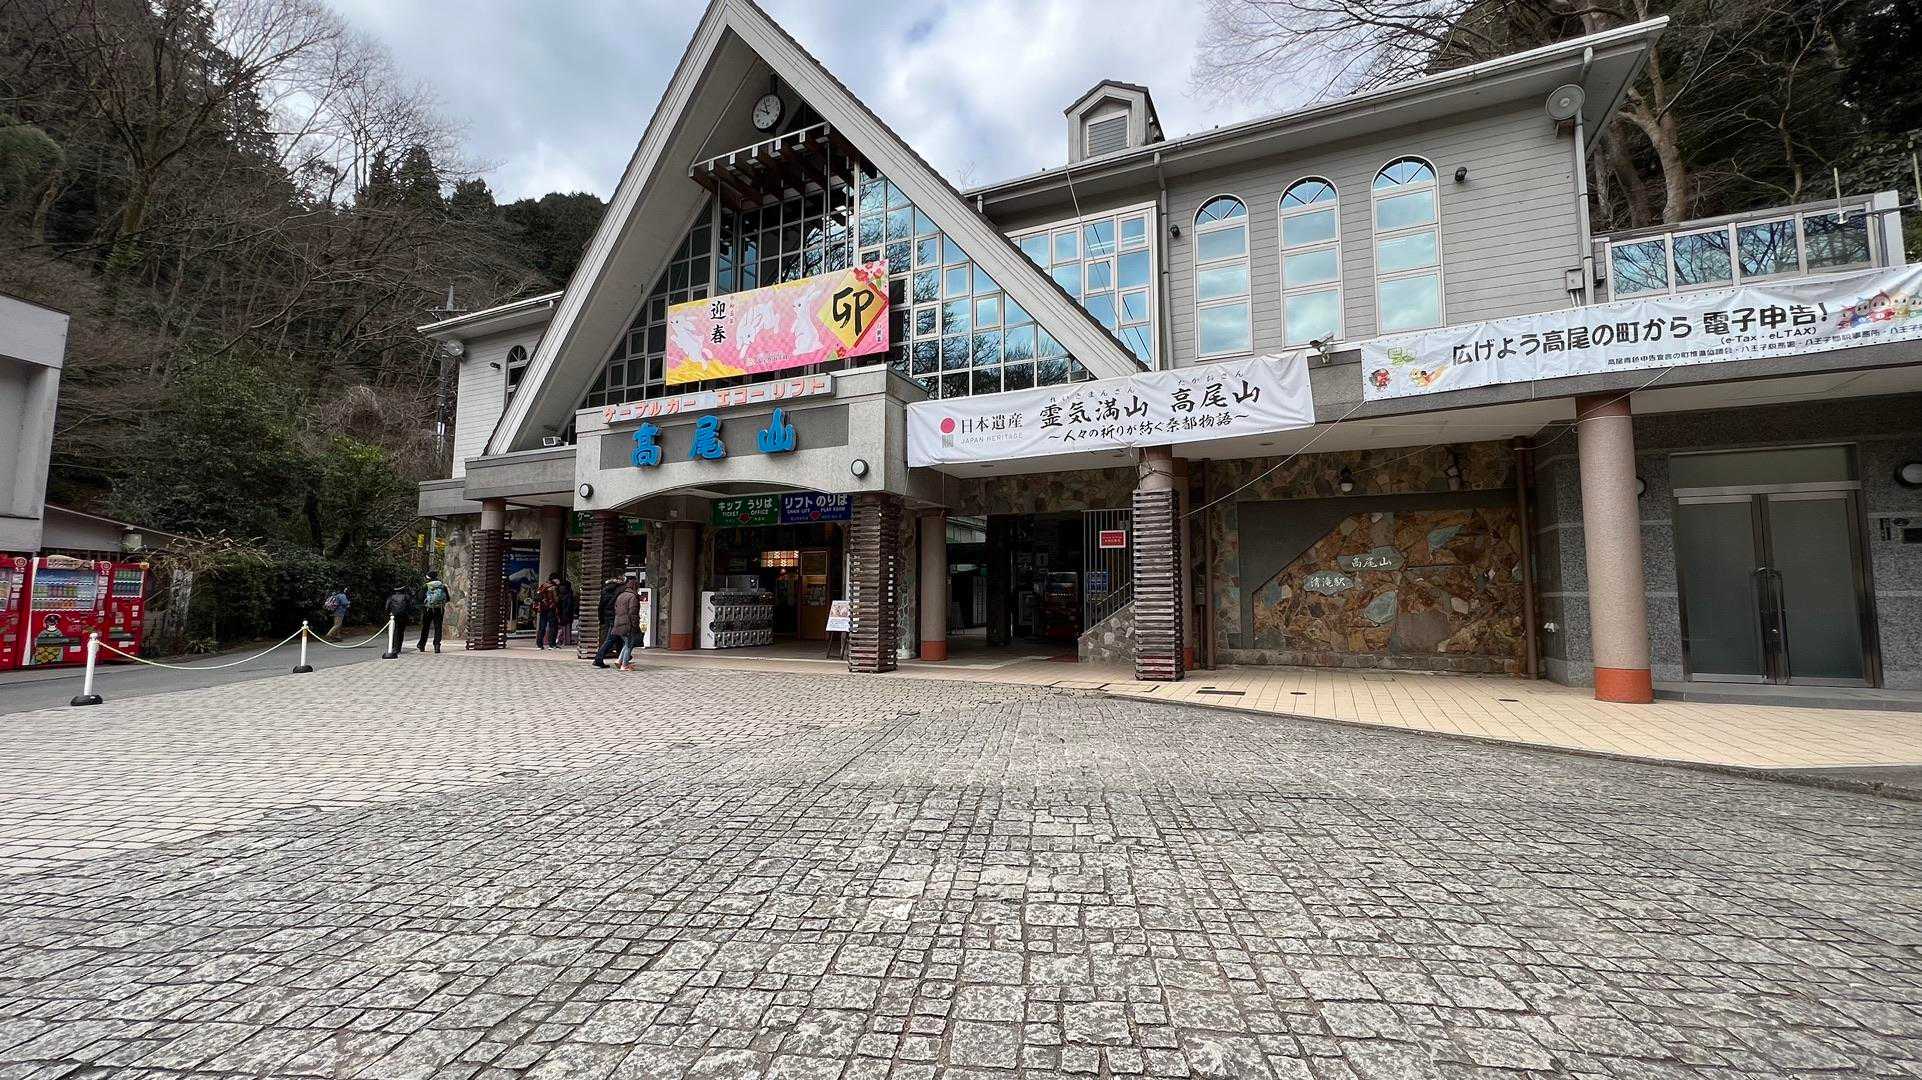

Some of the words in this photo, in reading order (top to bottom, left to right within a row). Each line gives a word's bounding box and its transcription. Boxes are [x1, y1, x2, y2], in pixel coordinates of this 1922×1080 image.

[710, 300, 727, 344] 迎春
[832, 286, 875, 337] 卯
[1452, 315, 1692, 367] 広げよう高尾の町から
[601, 398, 697, 424] ケーブルカー
[1039, 395, 1149, 429] 霊気満山
[1171, 379, 1261, 413] 高尾山
[631, 407, 797, 468] 高尾山
[961, 412, 1023, 434] 日本遺産
[961, 437, 984, 445] JAPAN
[986, 432, 1023, 442] HERITAGE
[785, 496, 813, 509] リフト
[816, 494, 848, 507] のりば
[1351, 556, 1392, 568] 高尾山
